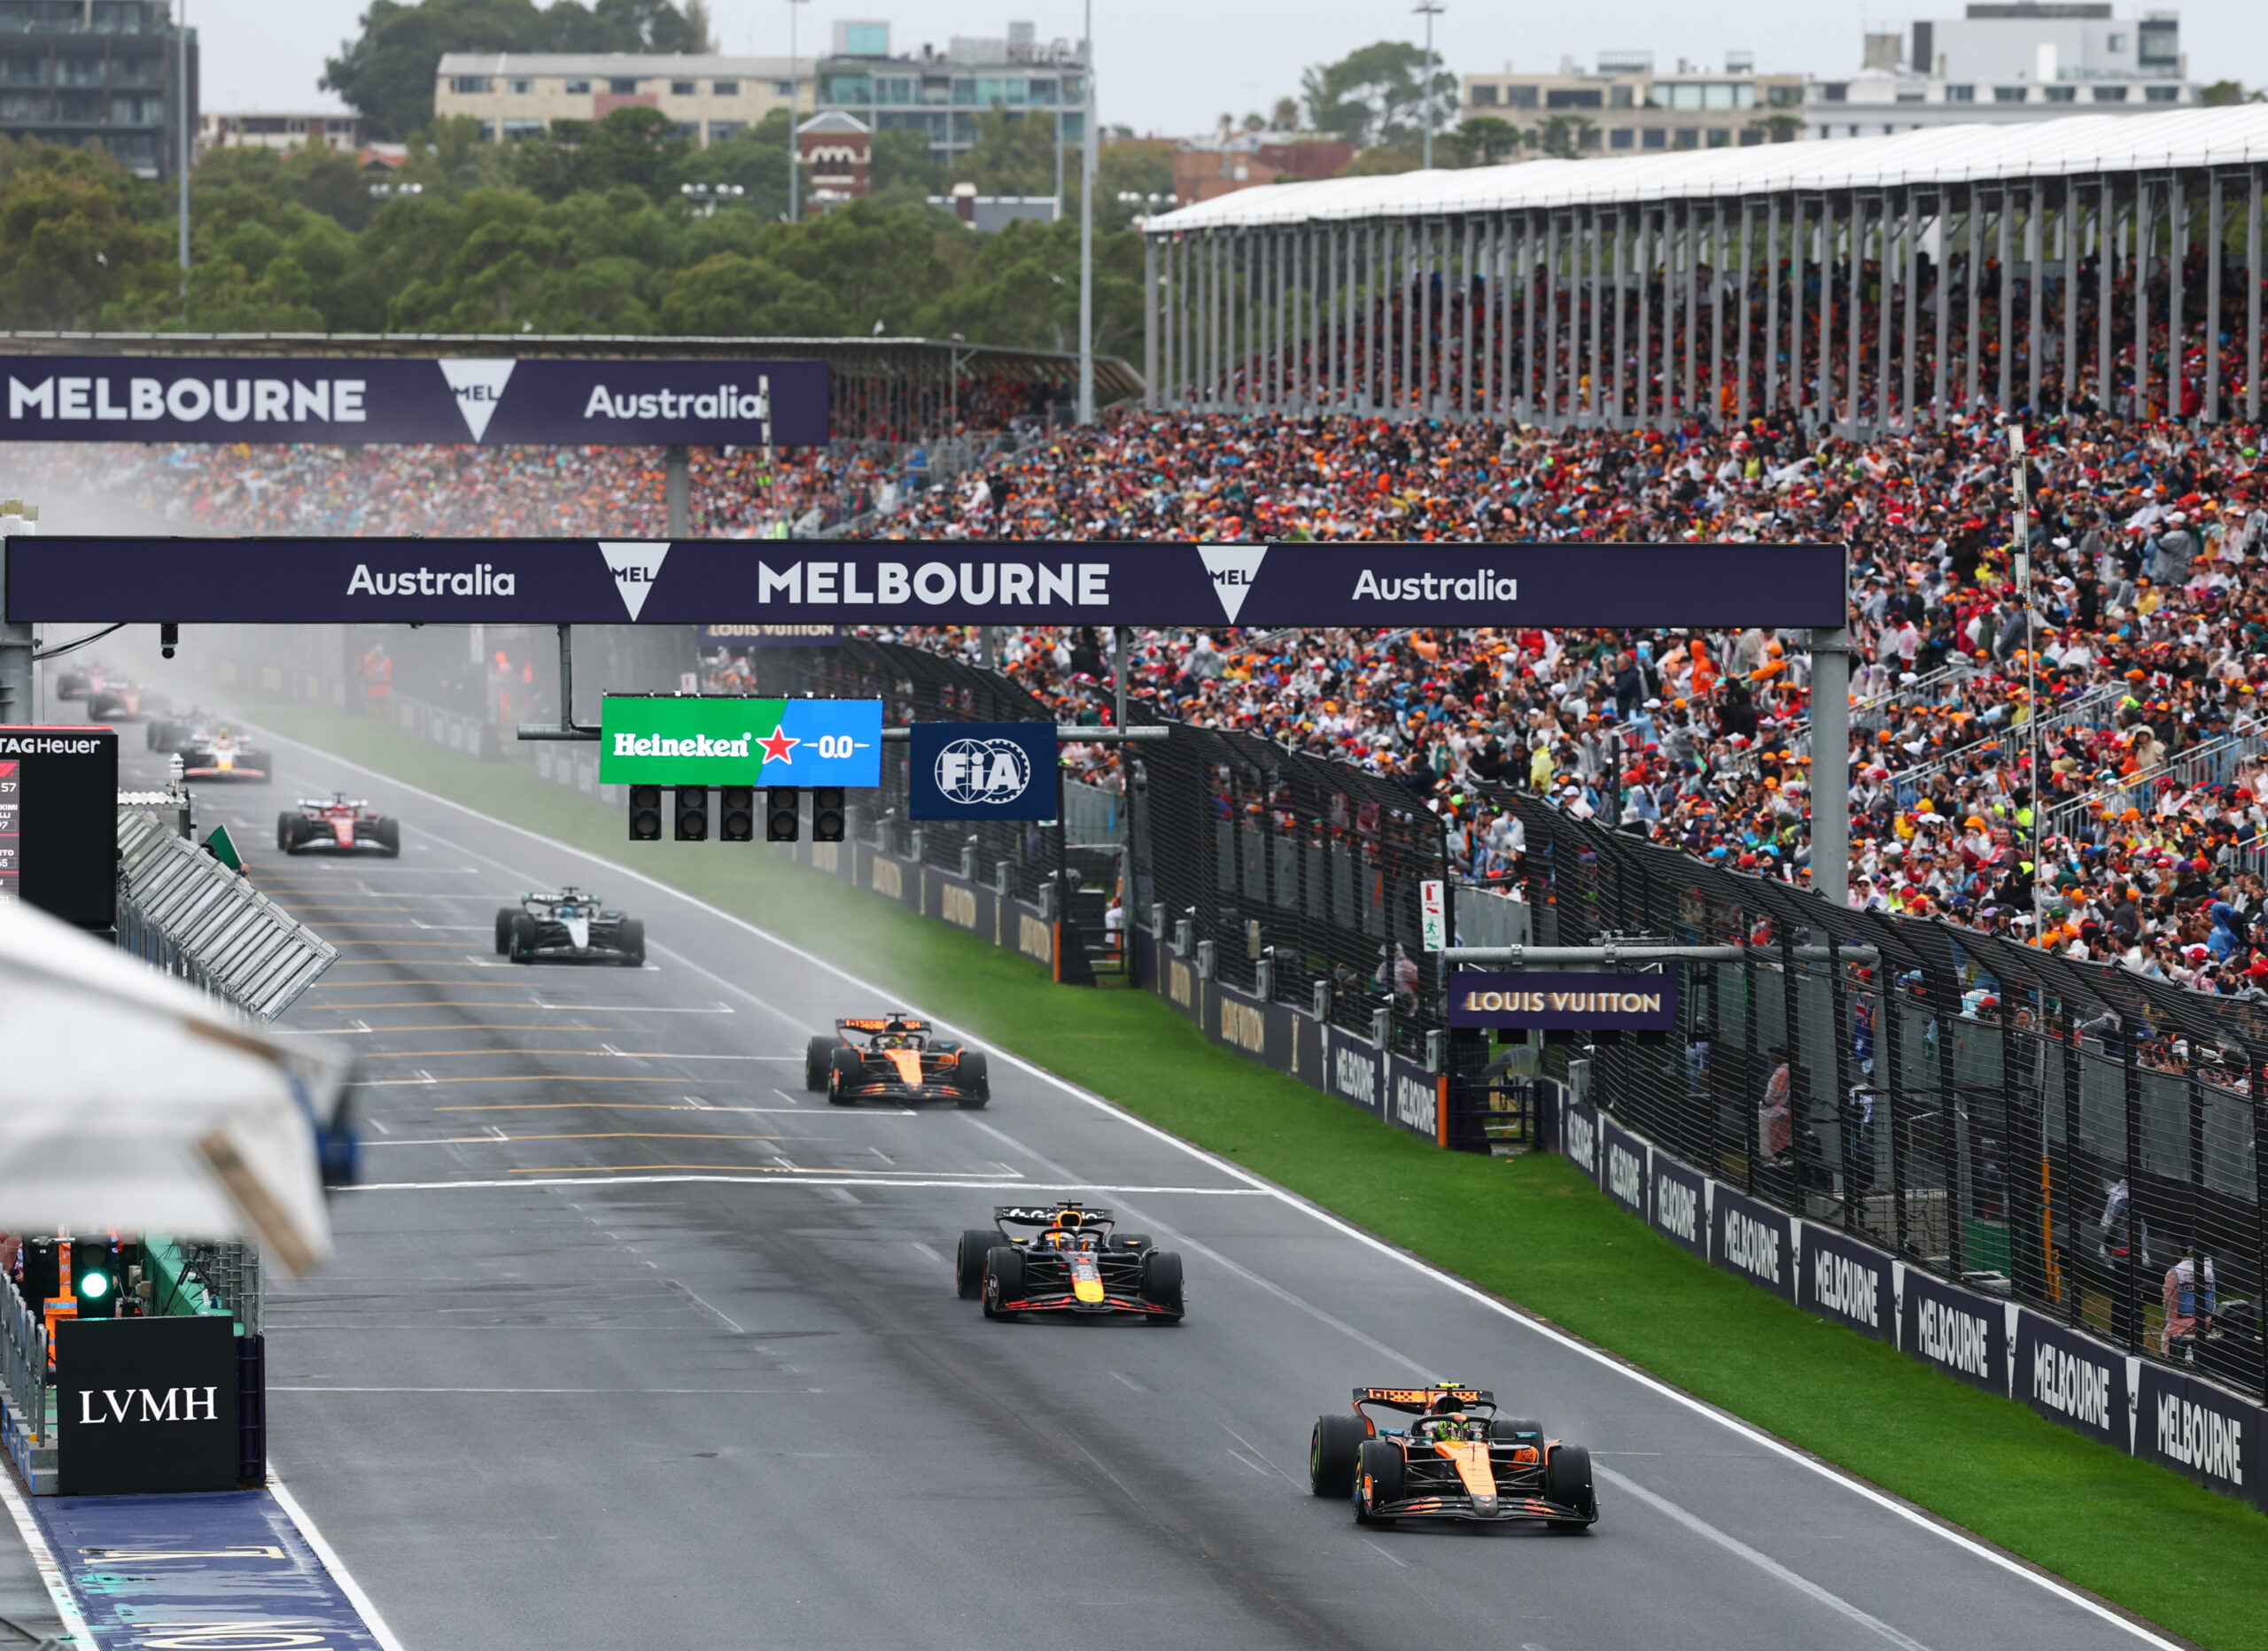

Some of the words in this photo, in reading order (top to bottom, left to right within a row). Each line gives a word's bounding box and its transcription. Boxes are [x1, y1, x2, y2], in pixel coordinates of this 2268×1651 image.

[9, 376, 367, 422] MELBOURNE
[451, 384, 499, 401] MEL
[583, 384, 765, 420] Australia
[346, 563, 515, 596] Australia
[610, 565, 656, 583] MEL
[757, 560, 1110, 606] MELBOURNE
[1209, 569, 1253, 585] MEL
[1351, 569, 1518, 601] Australia
[1466, 991, 1544, 1012] LOUIS
[1552, 992, 1661, 1012] VUITTON
[1608, 1142, 1640, 1209] MELBOURNE
[1658, 1174, 1697, 1243] MELBOURNE
[1724, 1206, 1780, 1284] MELBOURNE
[1814, 1247, 1878, 1328] MELBOURNE
[1918, 1296, 1988, 1379] MELBOURNE
[78, 1386, 219, 1424] LVMH
[2033, 1338, 2110, 1430] MELBOURNE
[2157, 1389, 2243, 1485] MELBOURNE
